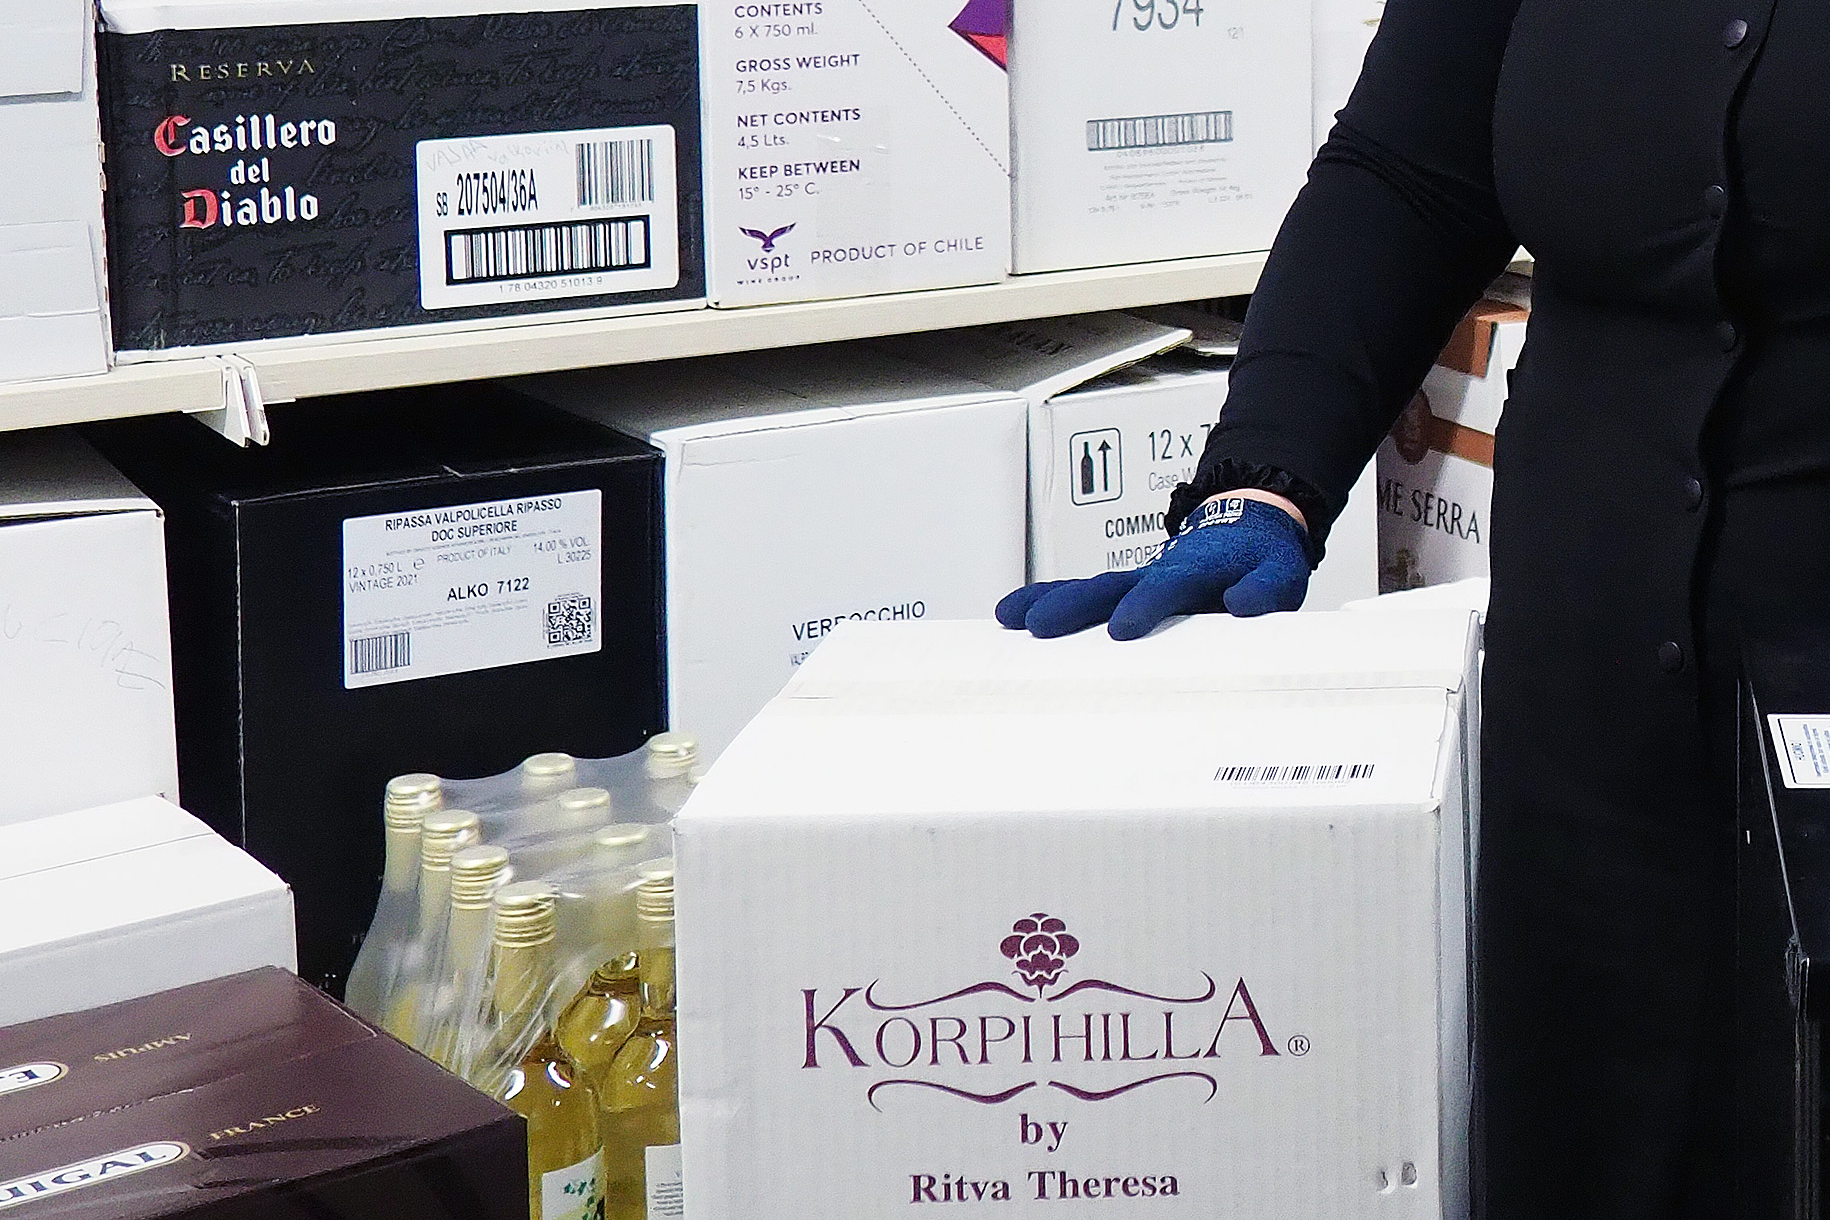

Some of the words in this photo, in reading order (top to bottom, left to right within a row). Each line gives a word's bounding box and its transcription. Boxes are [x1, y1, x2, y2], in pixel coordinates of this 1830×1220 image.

[734, 1, 823, 19] CONTENTS
[734, 24, 743, 39] 6
[748, 23, 760, 38] X
[763, 21, 792, 38] 750
[796, 20, 818, 37] ml.
[171, 60, 316, 81] RESERVA
[736, 55, 791, 72] GROSS
[796, 52, 860, 70] WEIGHT
[736, 78, 757, 96] 7,5
[761, 77, 792, 98] Kgs.
[737, 111, 769, 128] NET
[774, 107, 861, 126] CONTENTS
[155, 115, 336, 157] Casillero
[737, 133, 758, 151] 4,5
[763, 131, 790, 148] Lts.
[230, 158, 269, 184] del
[738, 163, 778, 180] KEEP
[784, 159, 860, 177] BETWEEN
[436, 192, 448, 217] SB
[457, 168, 538, 216] 207504/36A
[738, 184, 760, 201] 15°
[776, 182, 801, 199] 25°
[806, 181, 820, 196] C.
[179, 186, 318, 229] Diablo
[810, 244, 896, 265] PRODUCT
[904, 239, 927, 258] OF
[932, 235, 984, 255] CHILE
[747, 252, 791, 274] vspt
[509, 283, 521, 293] 78
[525, 280, 557, 292] 04320
[561, 277, 593, 289] 51013
[1148, 430, 1173, 463] 12
[1178, 435, 1194, 458] x
[1148, 469, 1179, 492] Case
[385, 515, 431, 531] RIPASSA
[435, 505, 514, 525] VALPOLICELLA
[516, 498, 562, 515] RIPASSO
[1104, 510, 1167, 540] COMMO
[1410, 489, 1481, 544] SERRA
[431, 527, 454, 542] DOC
[457, 520, 518, 539] SUPERIORE
[437, 550, 475, 564] PRODUCT
[477, 549, 488, 559] OF
[489, 546, 512, 558] ITALY
[557, 552, 563, 564] L
[348, 566, 359, 579] 12
[396, 562, 402, 573] L
[349, 577, 393, 594] VINTAGE
[396, 574, 419, 587] 2021
[447, 583, 489, 602] ALKO
[496, 577, 530, 594] 7122
[801, 976, 1281, 1070] KORPIHILLA
[208, 1103, 322, 1141] FRANCE
[1019, 1114, 1069, 1151] by
[909, 1172, 1011, 1205] Ritva
[1027, 1167, 1181, 1200] Theresa
